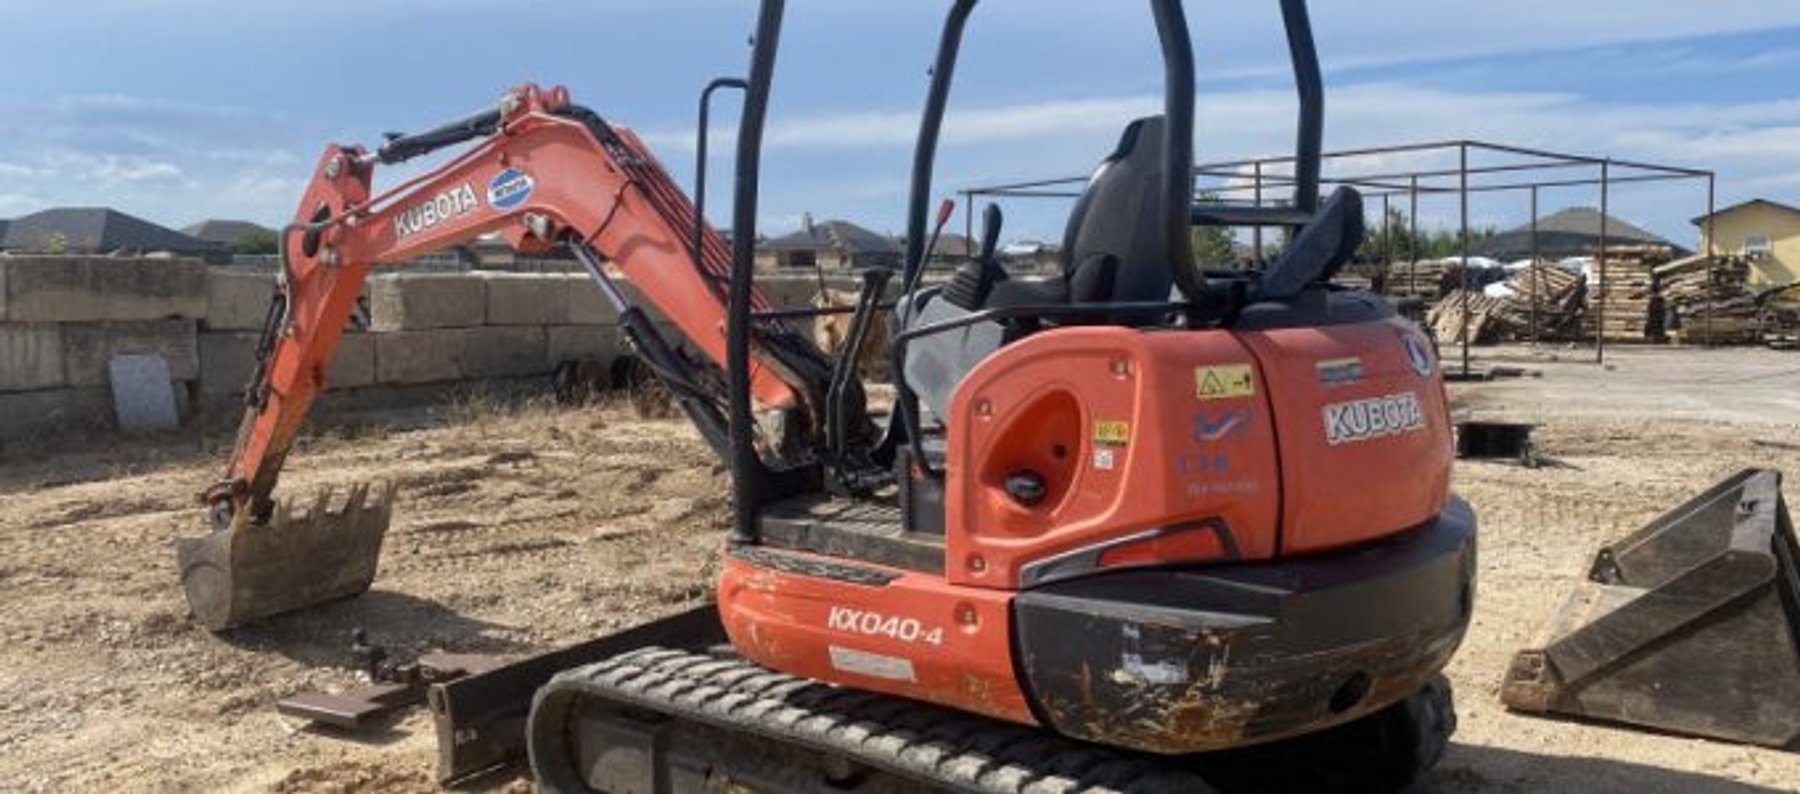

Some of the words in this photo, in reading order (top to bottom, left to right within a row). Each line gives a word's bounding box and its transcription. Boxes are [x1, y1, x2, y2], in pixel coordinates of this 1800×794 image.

[395, 183, 477, 236] KUBOTA
[1326, 393, 1422, 441] KUBOTA
[828, 606, 942, 644] KX040-4
